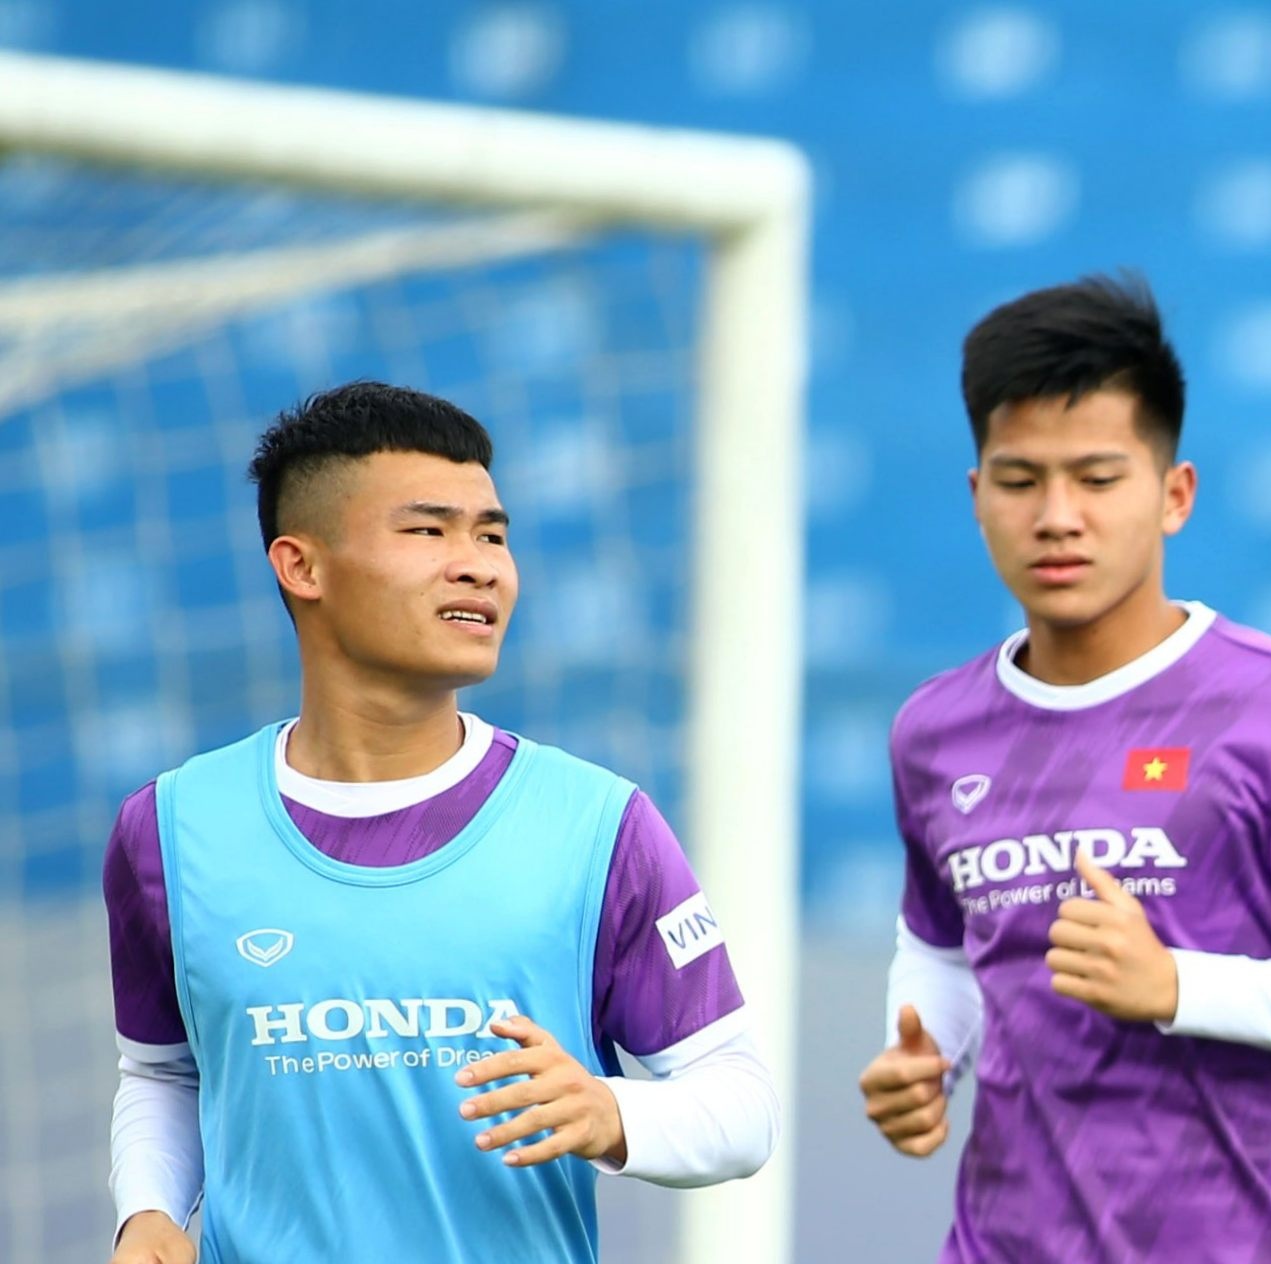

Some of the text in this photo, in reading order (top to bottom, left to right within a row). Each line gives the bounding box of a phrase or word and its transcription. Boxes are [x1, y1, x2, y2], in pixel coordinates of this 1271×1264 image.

[949, 827, 1187, 892] HONDA
[988, 882, 1053, 911] Power
[1056, 877, 1077, 899] of
[246, 998, 521, 1046] HONDA
[265, 1055, 314, 1076] The
[317, 1050, 399, 1072] Power
[402, 1048, 431, 1068] of
